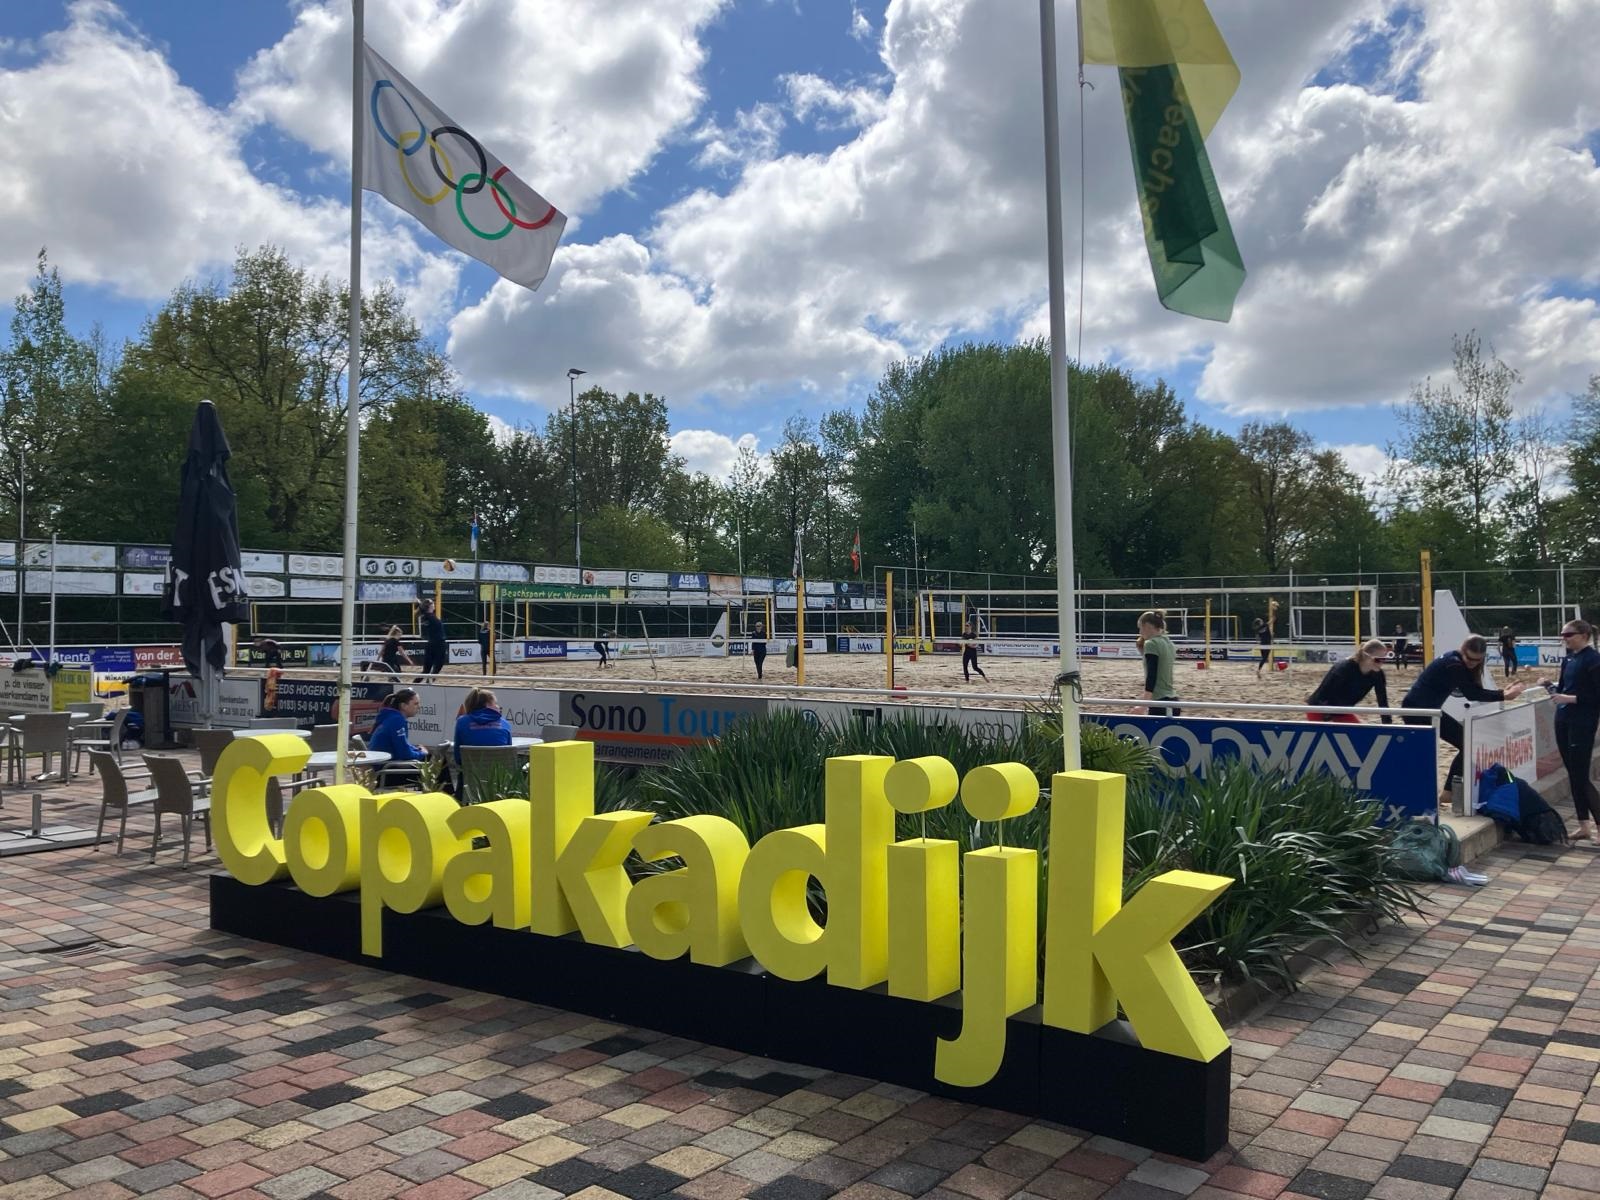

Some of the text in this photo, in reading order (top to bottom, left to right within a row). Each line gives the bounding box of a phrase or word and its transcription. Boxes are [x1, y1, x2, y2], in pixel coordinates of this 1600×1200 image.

[136, 652, 155, 660] van
[156, 650, 175, 660] der
[528, 645, 563, 655] Rabobank
[296, 685, 325, 697] HOGER
[506, 707, 554, 727] Advies
[571, 693, 646, 733] Sono
[211, 733, 1234, 1088] Copakadijk
